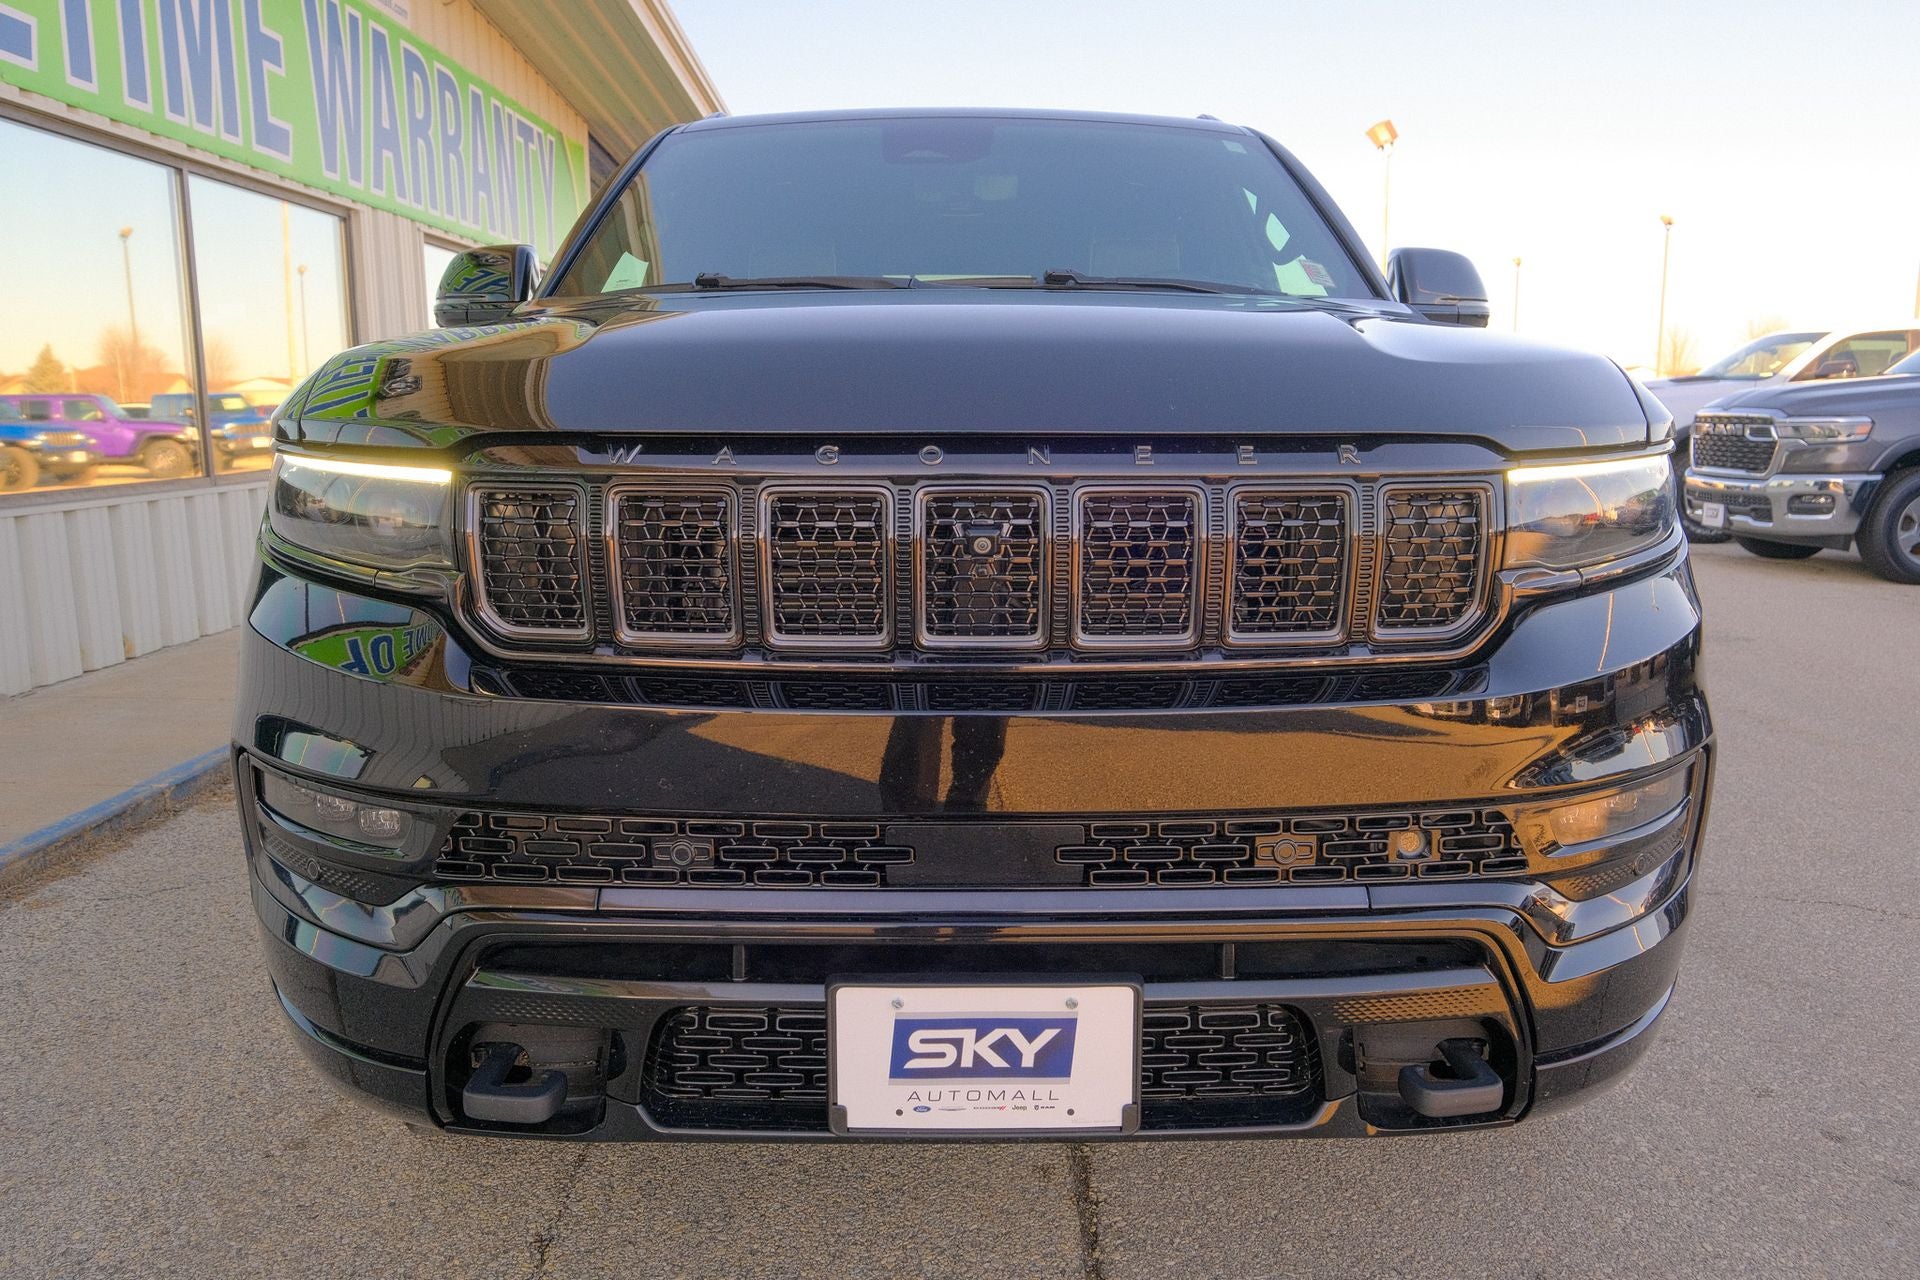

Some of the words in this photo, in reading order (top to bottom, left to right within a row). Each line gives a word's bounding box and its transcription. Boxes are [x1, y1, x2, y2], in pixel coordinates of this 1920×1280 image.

[302, 0, 556, 257] WARRANTY
[606, 443, 1361, 465] WAGONEER
[903, 1028, 1062, 1069] SKY
[907, 1089, 1060, 1102] AUTOMALL
